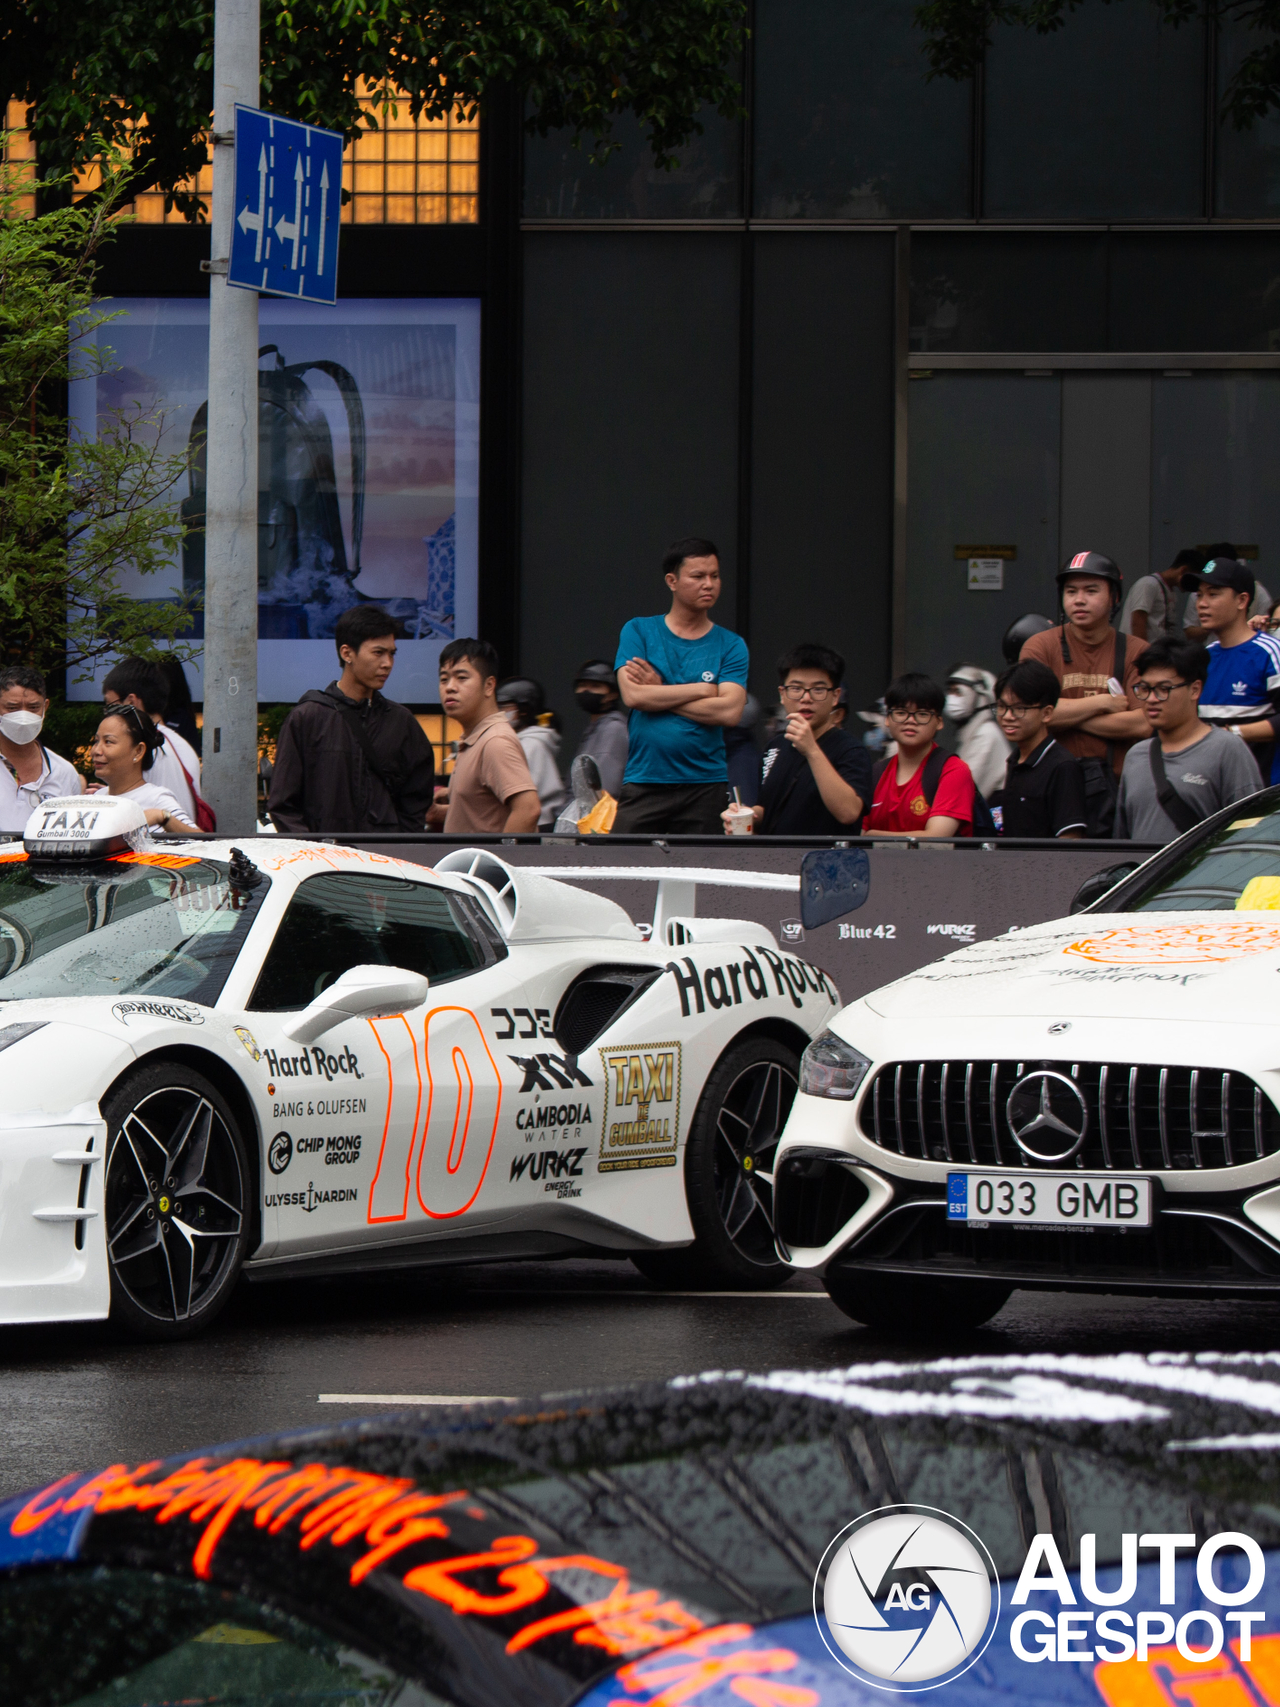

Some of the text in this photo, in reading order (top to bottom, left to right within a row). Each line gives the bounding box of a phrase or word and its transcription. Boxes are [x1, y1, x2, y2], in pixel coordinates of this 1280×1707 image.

[42, 811, 100, 830] TAXI
[36, 830, 90, 839] Gumball 3000
[838, 923, 896, 940] Blue 42
[927, 924, 977, 936] WURKZ
[666, 946, 837, 1017] Hard Rock
[490, 1007, 558, 1040] DDE
[263, 1045, 362, 1081] Hard Rock
[608, 1052, 674, 1106] TAXI
[273, 1098, 367, 1118] BANG & OLUFSEN
[367, 1005, 503, 1225] 10
[515, 1103, 592, 1130] CAMBODIA
[637, 1103, 650, 1121] DE
[524, 1127, 582, 1143] WATER
[609, 1118, 672, 1148] GUMBALL
[296, 1135, 362, 1154] CHIP MONG
[325, 1150, 360, 1166] GROUP
[509, 1147, 589, 1183] WURKZ
[544, 1180, 575, 1192] ENERGY
[557, 1188, 583, 1199] DRINK
[265, 1188, 358, 1207] ULYSSE NARDIN
[976, 1179, 1139, 1219] 033 GMB
[949, 1203, 967, 1214] EST
